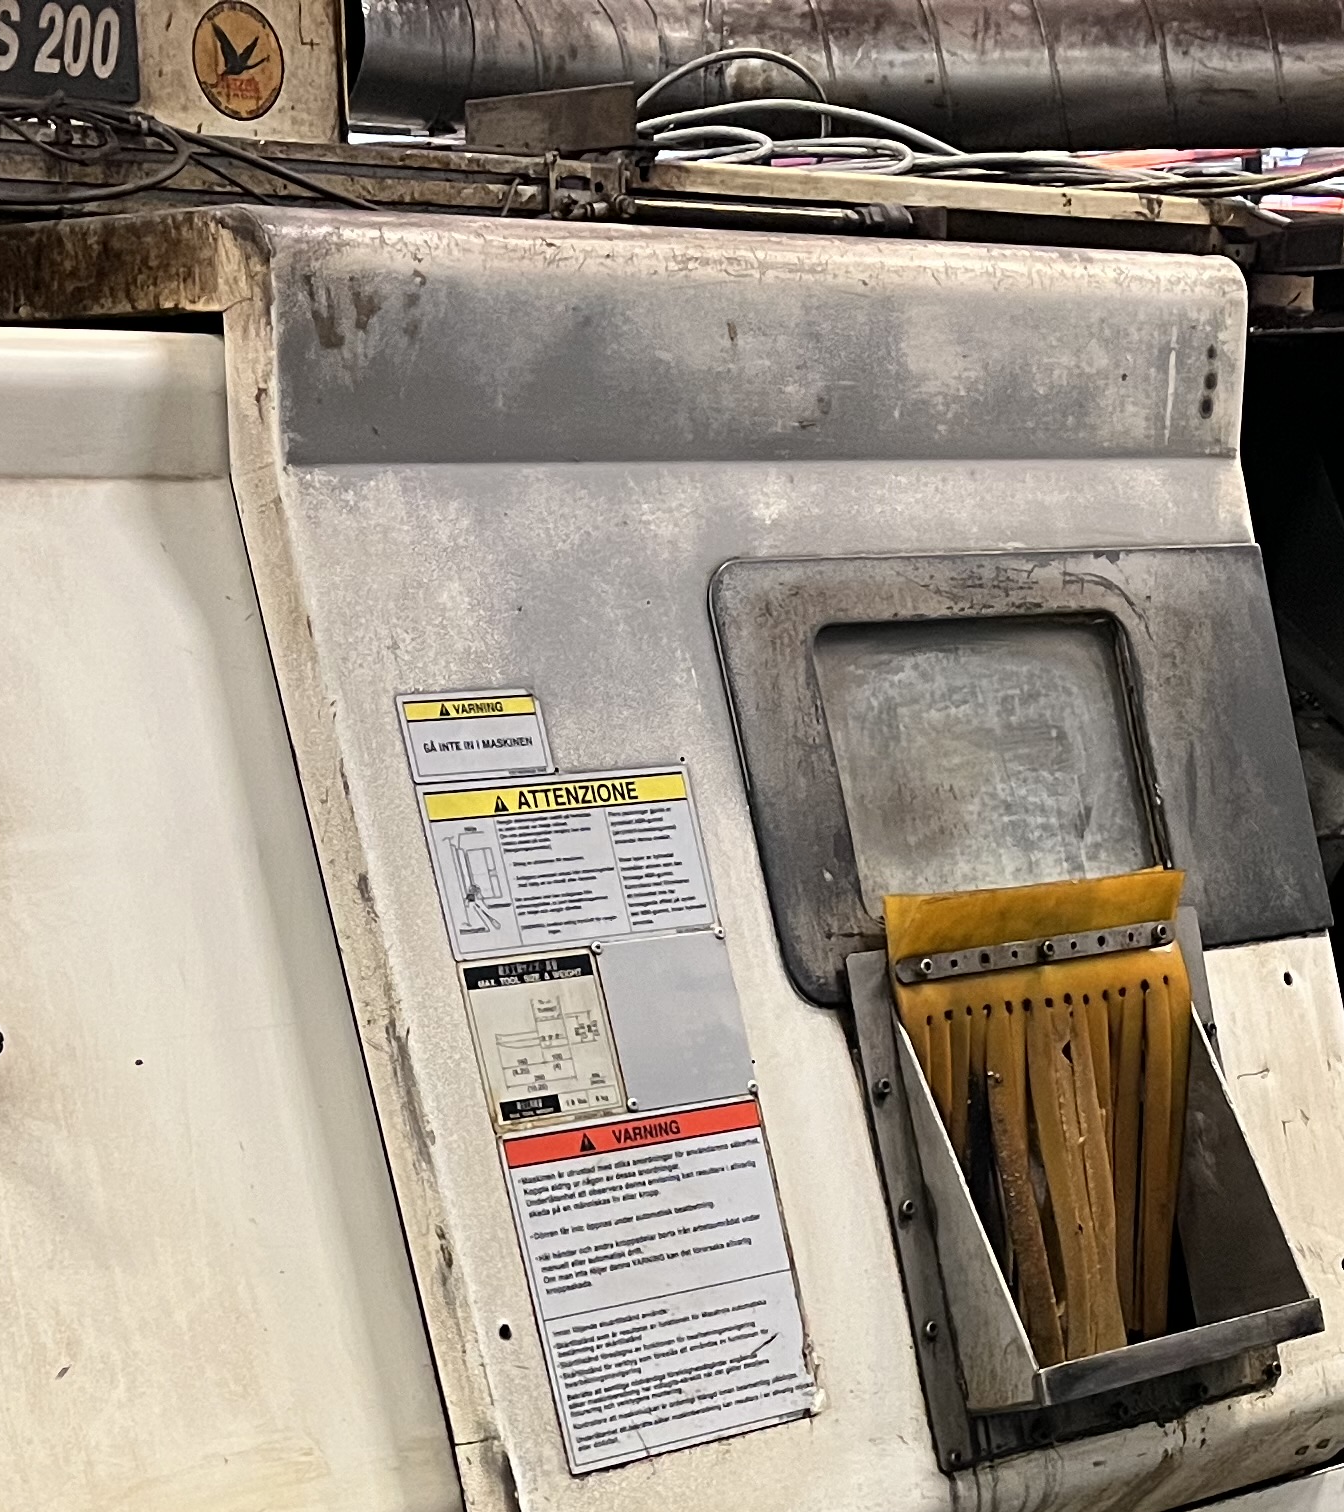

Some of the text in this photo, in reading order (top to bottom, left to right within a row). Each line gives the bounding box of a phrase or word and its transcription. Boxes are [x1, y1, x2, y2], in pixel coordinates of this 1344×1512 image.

[33, 2, 120, 79] 200
[453, 701, 503, 714] VARNING
[423, 740, 437, 753] GÅ
[439, 741, 461, 751] INTE
[464, 741, 474, 749] IN
[482, 737, 532, 748] MASKINEN
[518, 782, 638, 809] ATTENZIONE
[612, 1120, 680, 1143] VARNING
